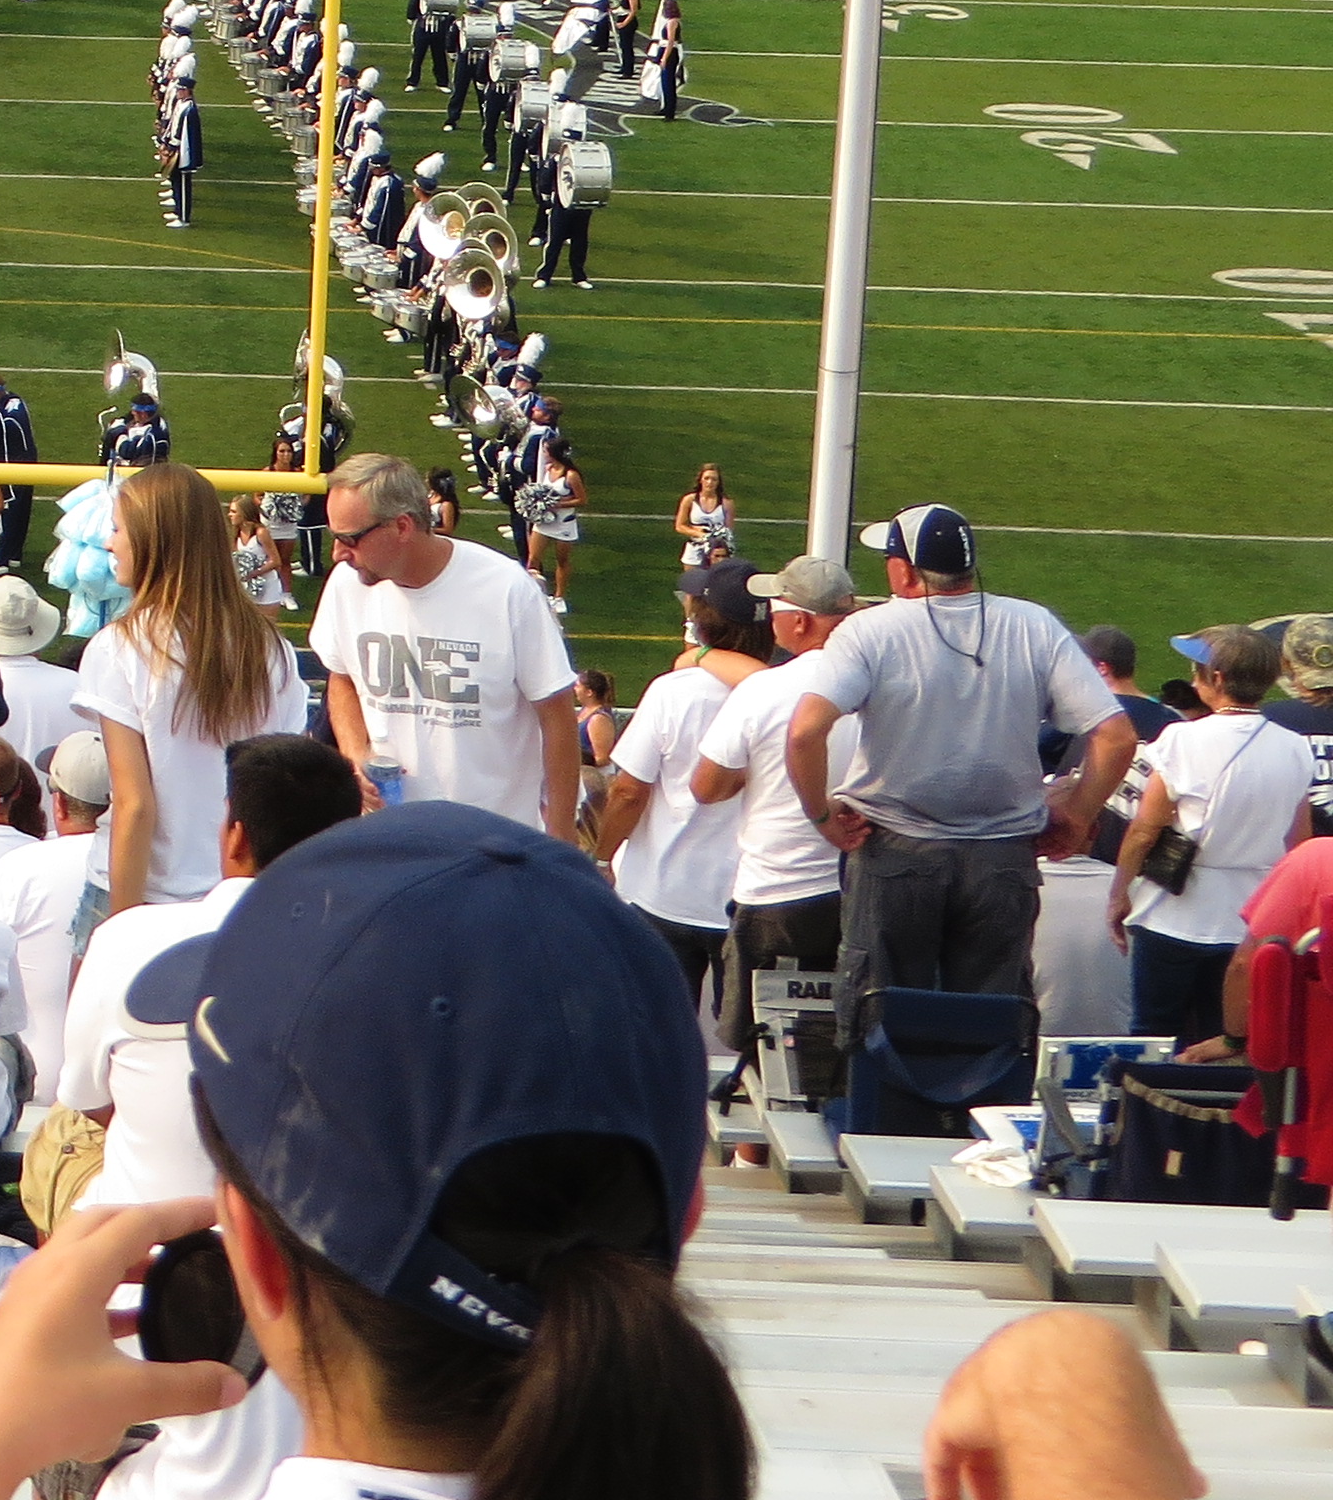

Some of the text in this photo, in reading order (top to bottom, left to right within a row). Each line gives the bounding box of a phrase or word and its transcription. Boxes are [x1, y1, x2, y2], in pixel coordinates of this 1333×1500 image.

[438, 641, 479, 653] NEVADA
[357, 632, 481, 704] ONE
[453, 708, 481, 719] PACK
